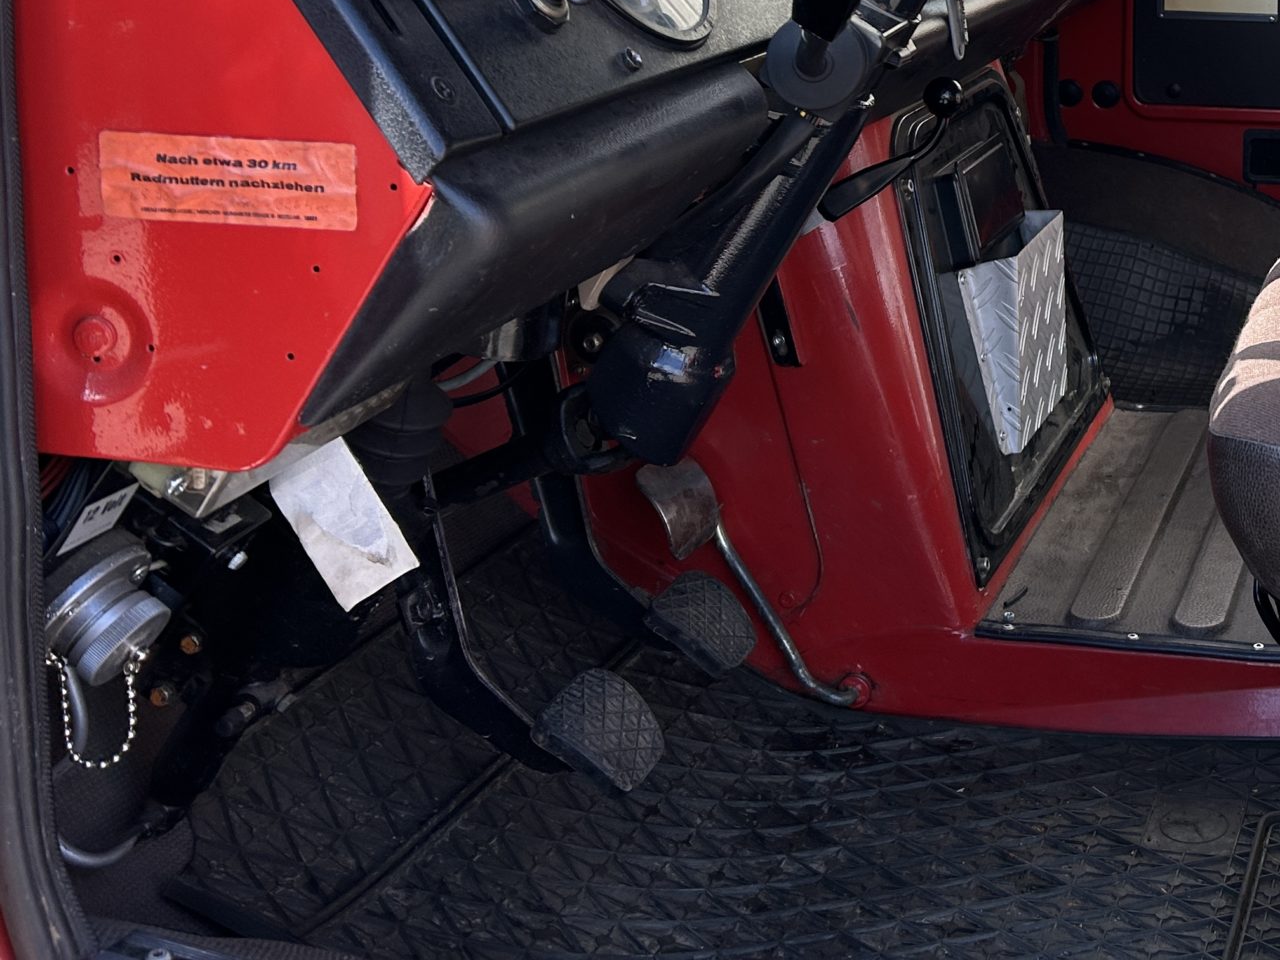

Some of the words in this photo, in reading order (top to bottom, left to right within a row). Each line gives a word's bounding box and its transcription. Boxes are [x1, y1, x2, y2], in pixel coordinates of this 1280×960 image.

[156, 152, 198, 166] Nach
[203, 154, 243, 168] etwa
[246, 158, 269, 170] 30
[271, 158, 297, 171] km
[130, 171, 225, 188] Radmuttern
[229, 176, 325, 193] nachziehen
